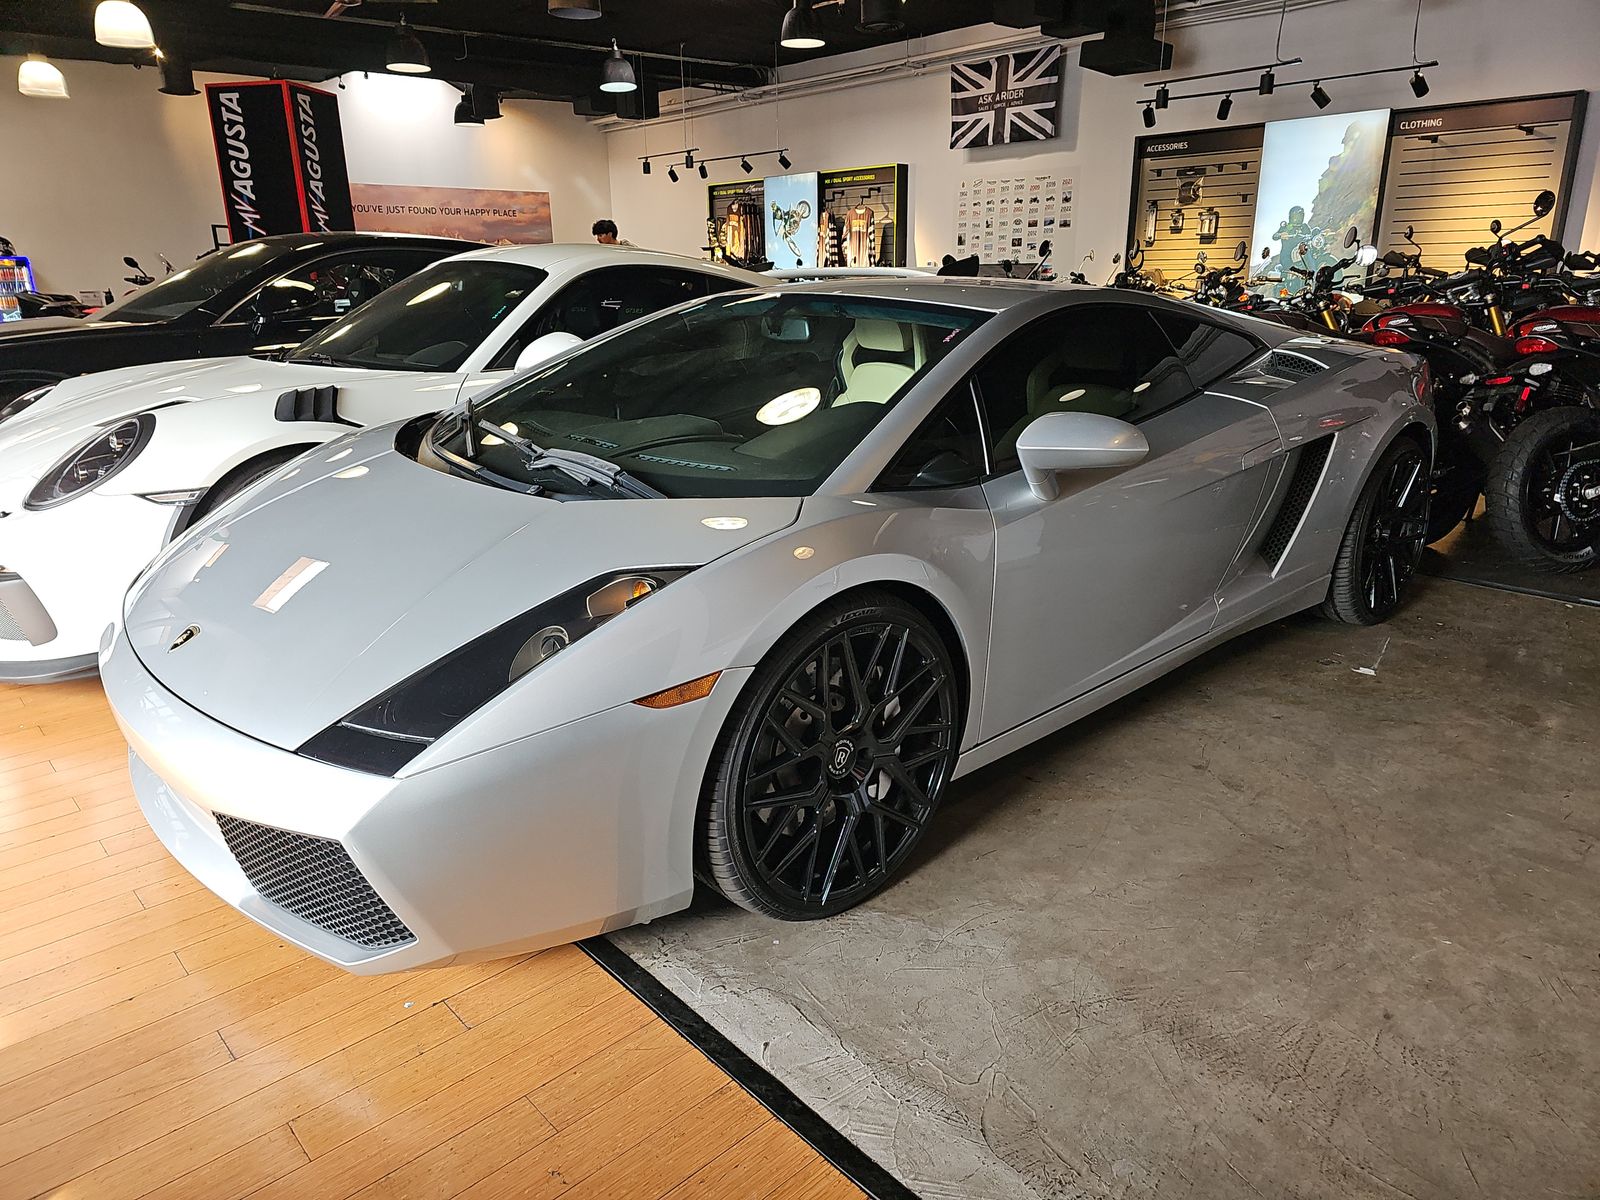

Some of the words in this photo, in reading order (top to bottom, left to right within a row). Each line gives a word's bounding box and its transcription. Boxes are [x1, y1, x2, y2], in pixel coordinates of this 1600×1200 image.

[978, 94, 993, 105] ASK
[1001, 89, 1024, 100] RIDER
[1400, 118, 1443, 130] CLOTHING
[219, 92, 256, 201] AGUSTA
[297, 93, 326, 202] AGUSTA
[1146, 141, 1189, 153] ACCESSORIES
[351, 204, 383, 214] YOU'VE
[386, 205, 405, 215] JUST
[408, 206, 437, 215] FOUND
[439, 207, 462, 216] YOUR
[464, 208, 491, 217] HAPPY
[493, 209, 518, 218] PLACE
[837, 751, 846, 764] R
